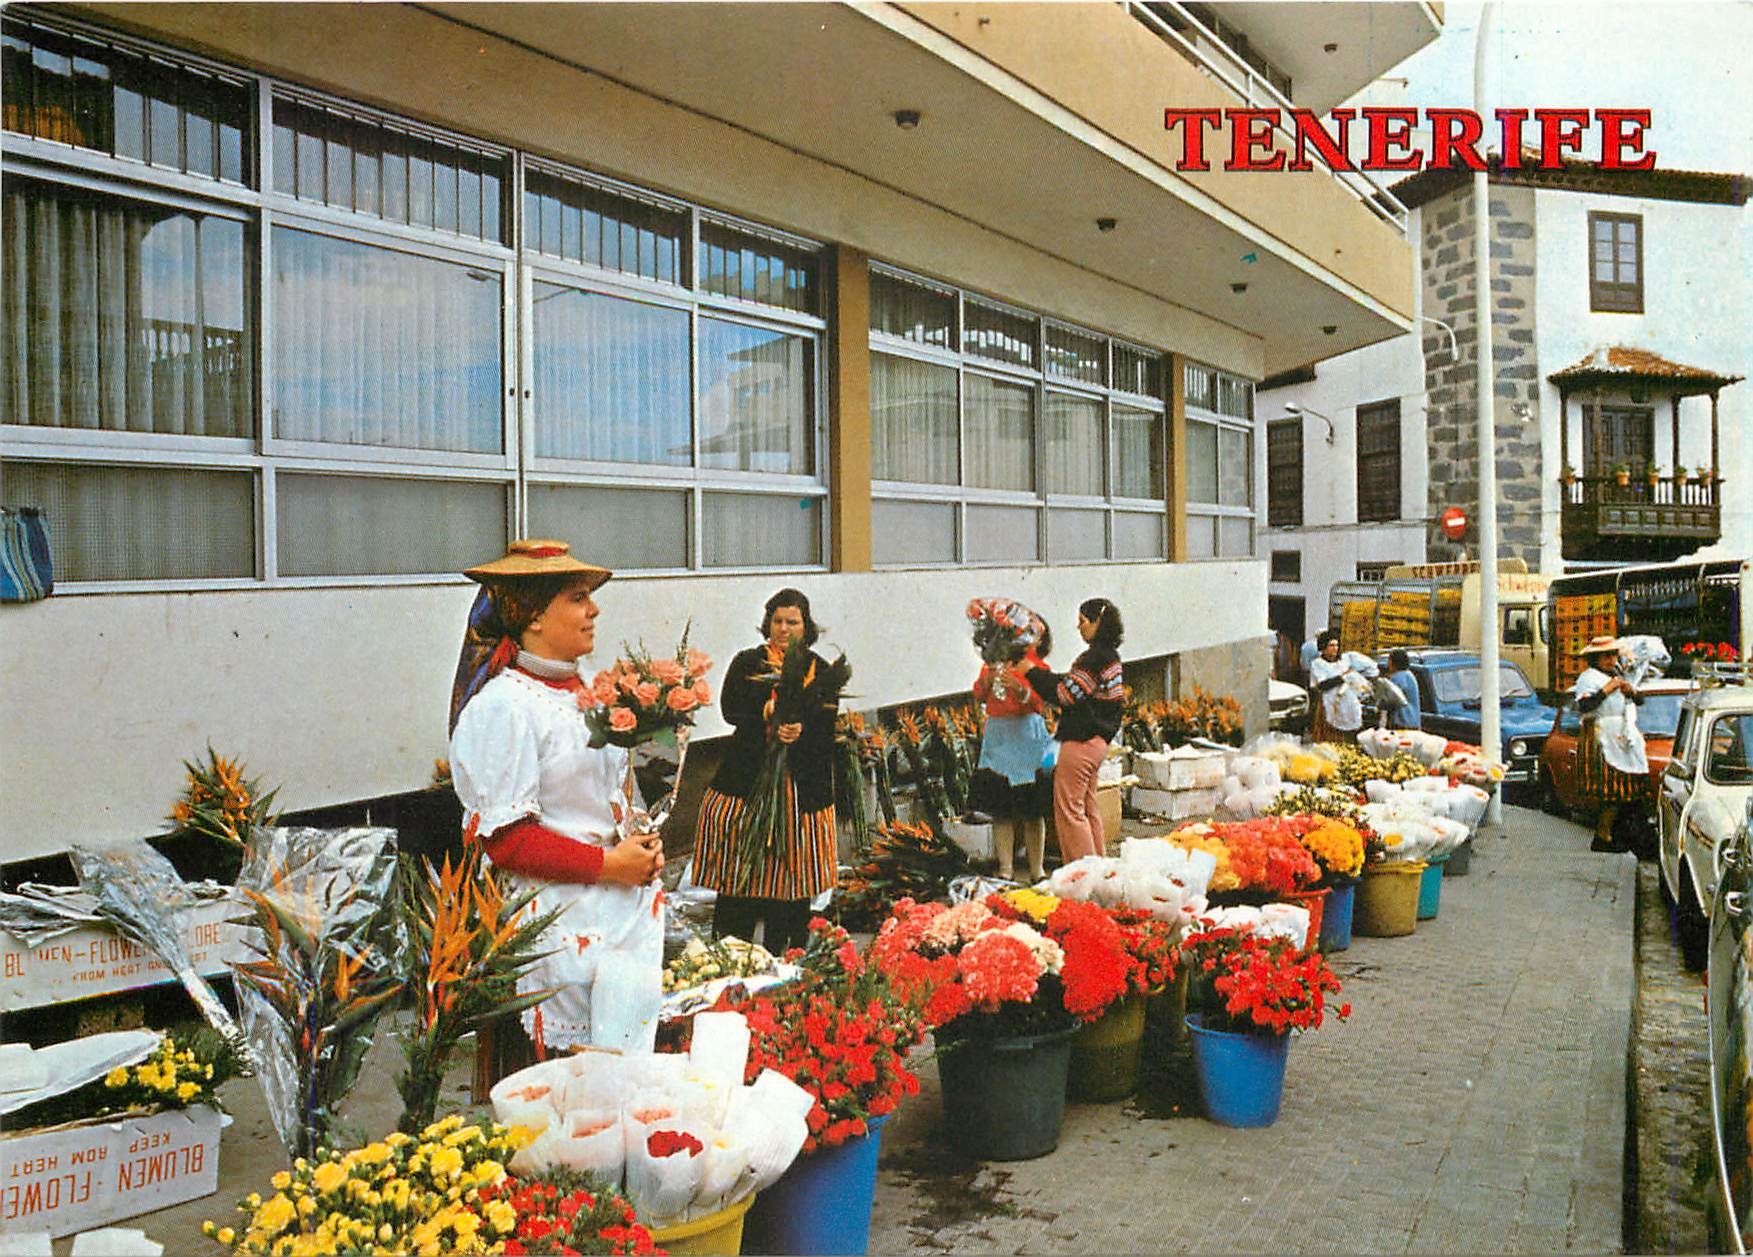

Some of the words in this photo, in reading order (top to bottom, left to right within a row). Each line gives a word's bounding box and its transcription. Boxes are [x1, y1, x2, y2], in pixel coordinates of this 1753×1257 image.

[129, 1131, 171, 1153] KEEP
[10, 1156, 58, 1178] HEAT
[117, 1143, 204, 1193] BLUMEN
[0, 1171, 91, 1220] FLOWE
